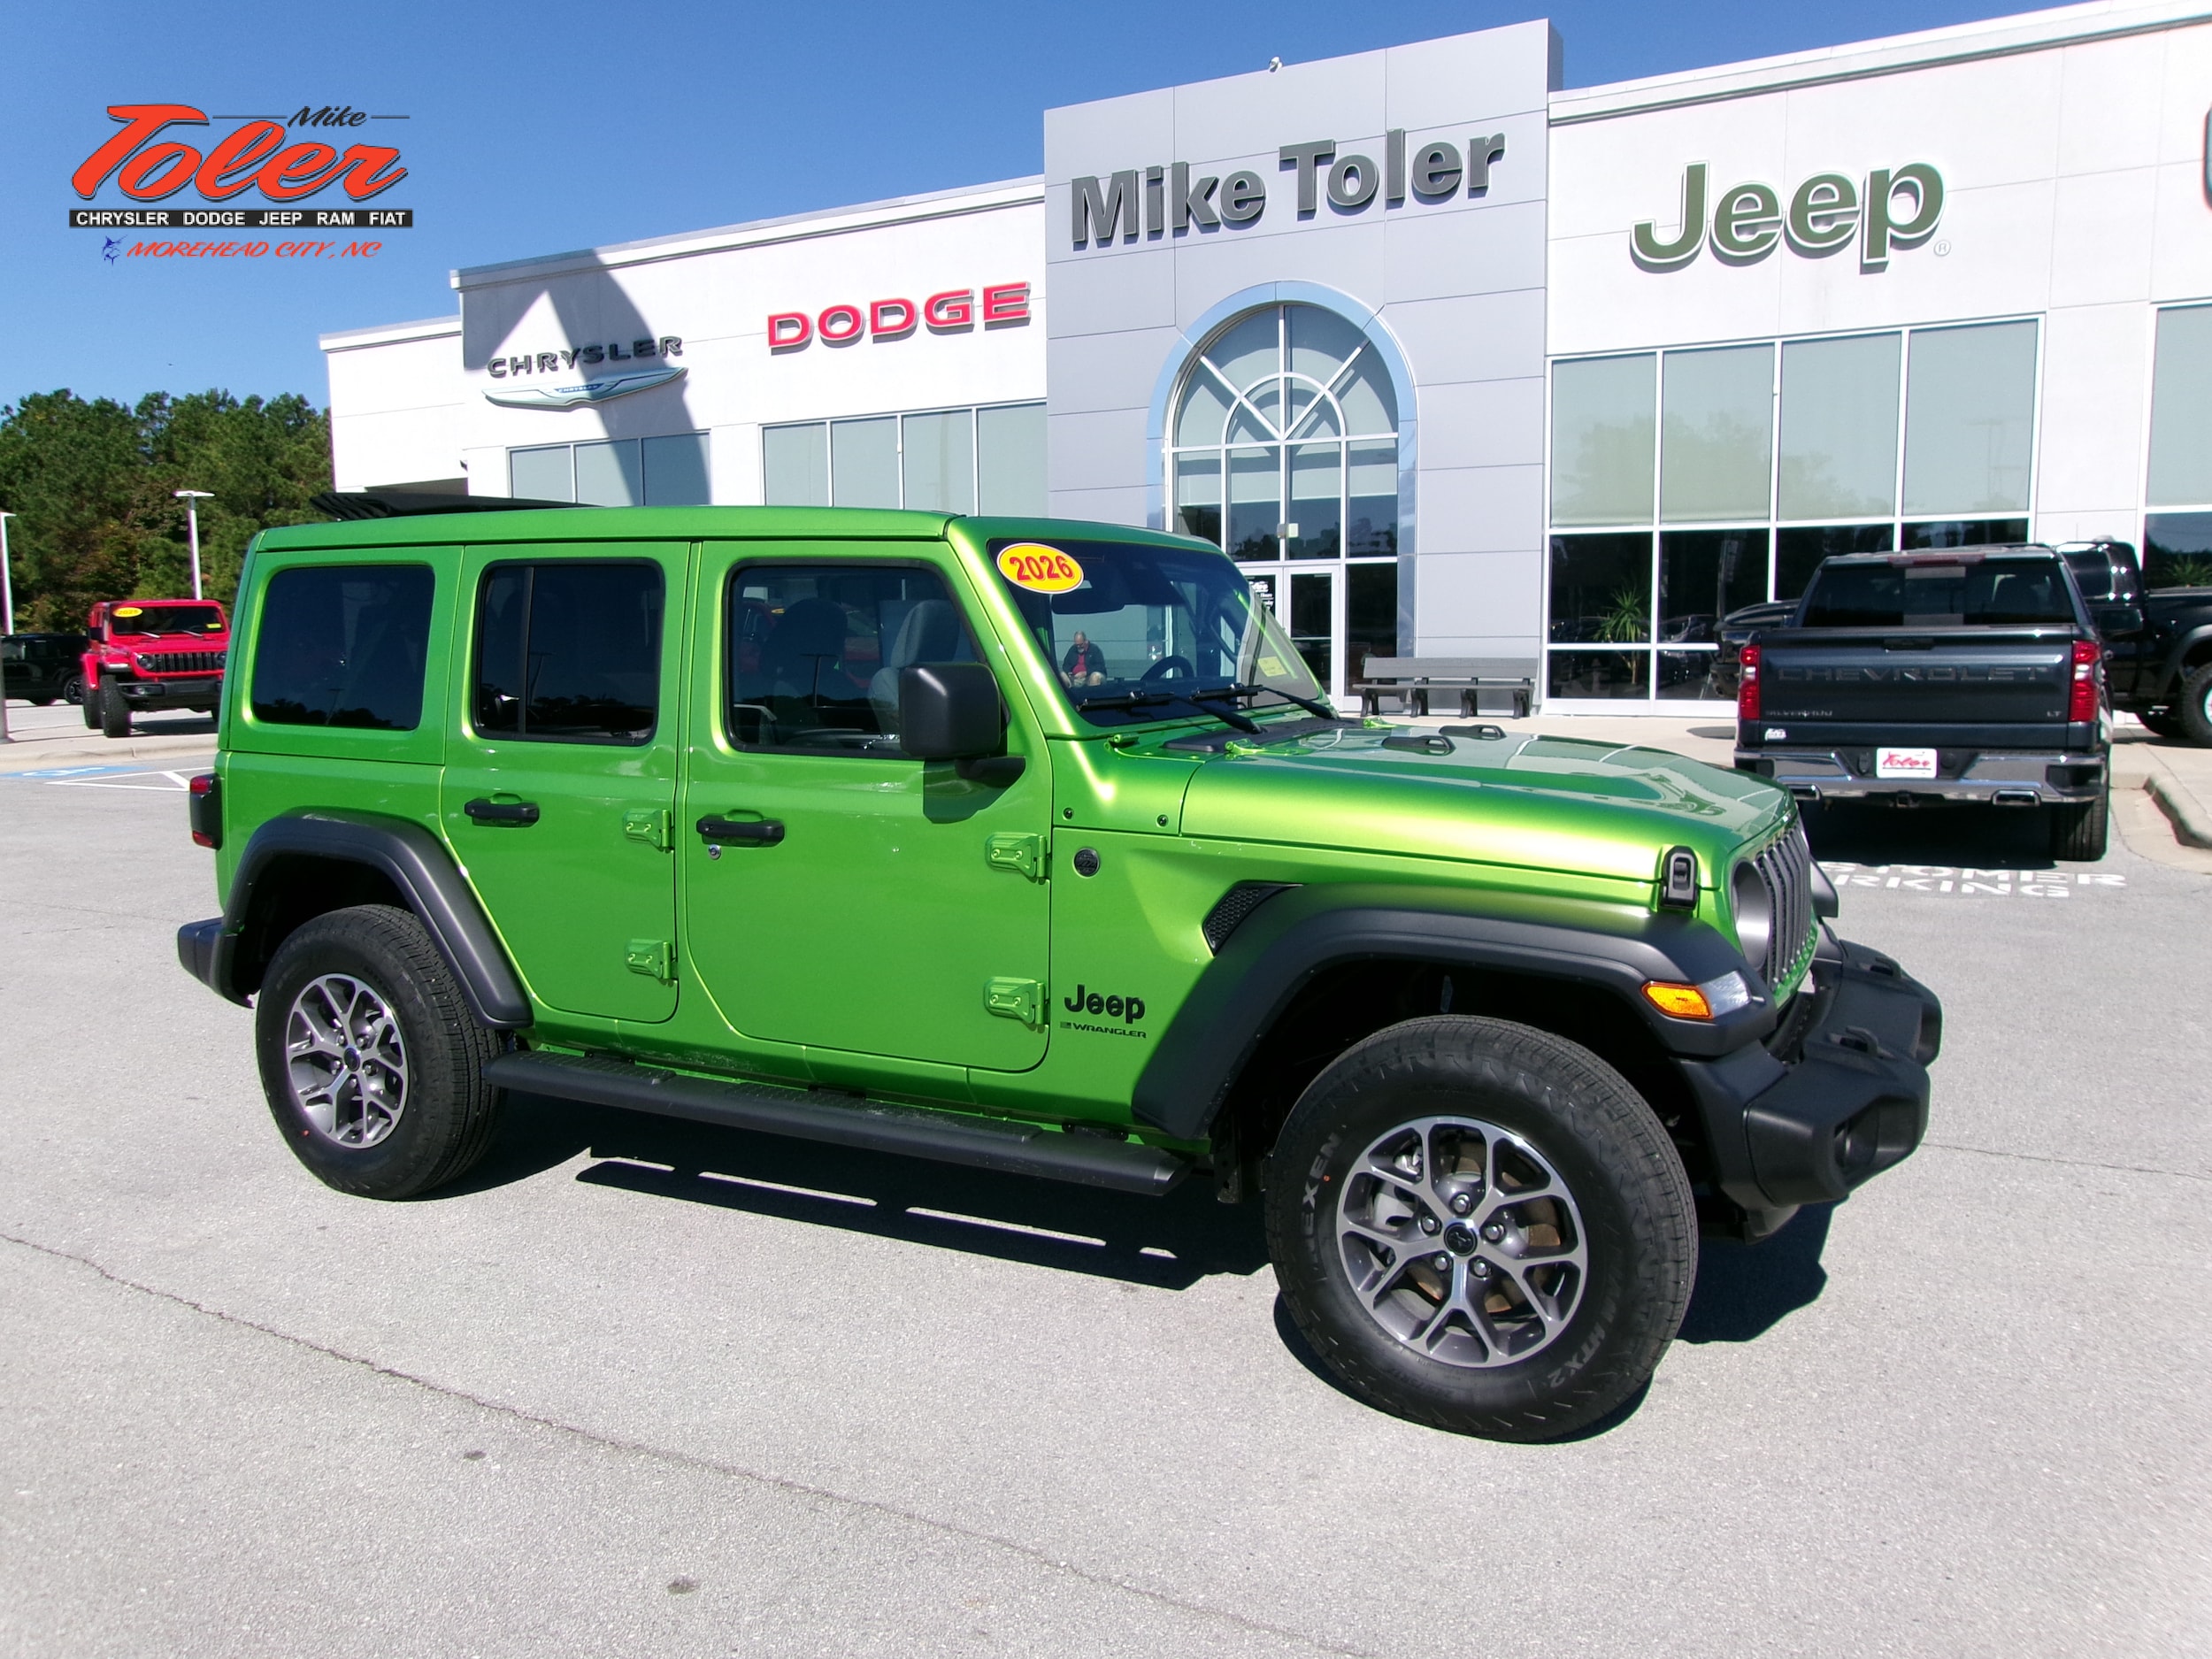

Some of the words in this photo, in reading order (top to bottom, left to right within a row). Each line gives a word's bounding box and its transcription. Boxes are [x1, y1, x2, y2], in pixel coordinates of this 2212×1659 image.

[1071, 161, 1267, 249] Mike
[1279, 128, 1506, 220] Toler
[1630, 160, 1946, 274] Jeep
[766, 281, 1031, 354] DODGE
[488, 335, 683, 379] CHRYSLER
[1009, 554, 1075, 583] 2026
[1778, 666, 2048, 681] CHEVROLET
[1812, 862, 2127, 886] STOMER
[1832, 873, 2070, 898] RKING
[1064, 984, 1146, 1024] Jeep
[1073, 1022, 1147, 1038] WRANGLER
